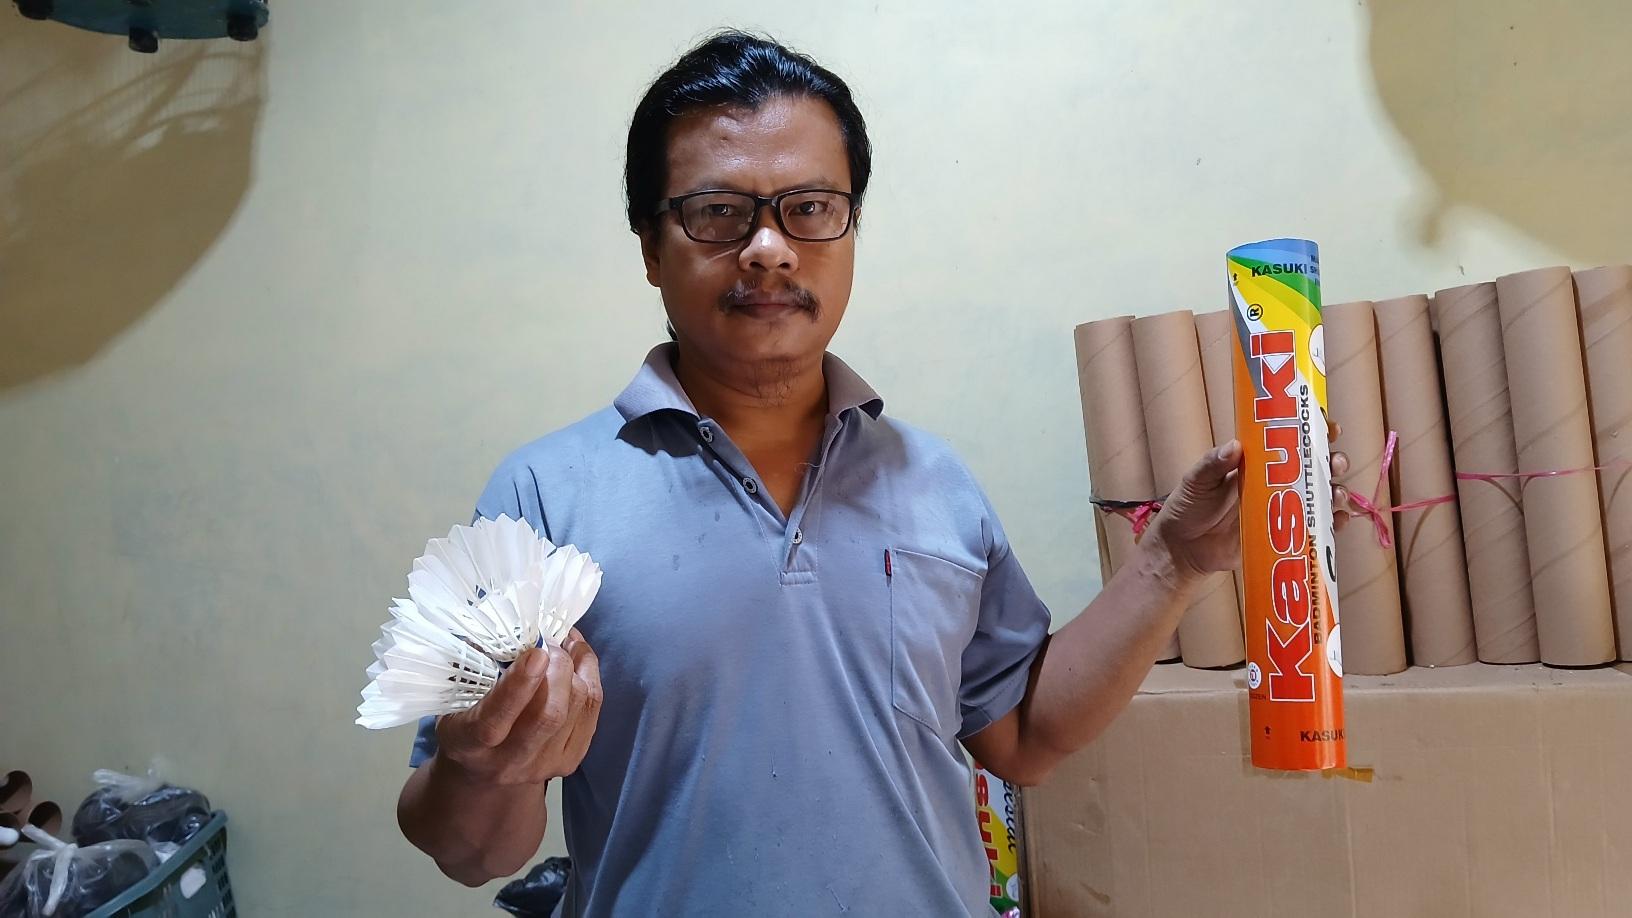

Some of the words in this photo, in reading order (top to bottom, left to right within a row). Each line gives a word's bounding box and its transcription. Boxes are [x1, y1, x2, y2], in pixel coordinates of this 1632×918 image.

[1251, 262, 1307, 278] KASUKI
[1299, 384, 1316, 527] SHUTTLECOCKS
[1250, 330, 1315, 702] Kasuki
[1308, 535, 1322, 645] BADMINTON
[1300, 728, 1345, 742] KASUK
